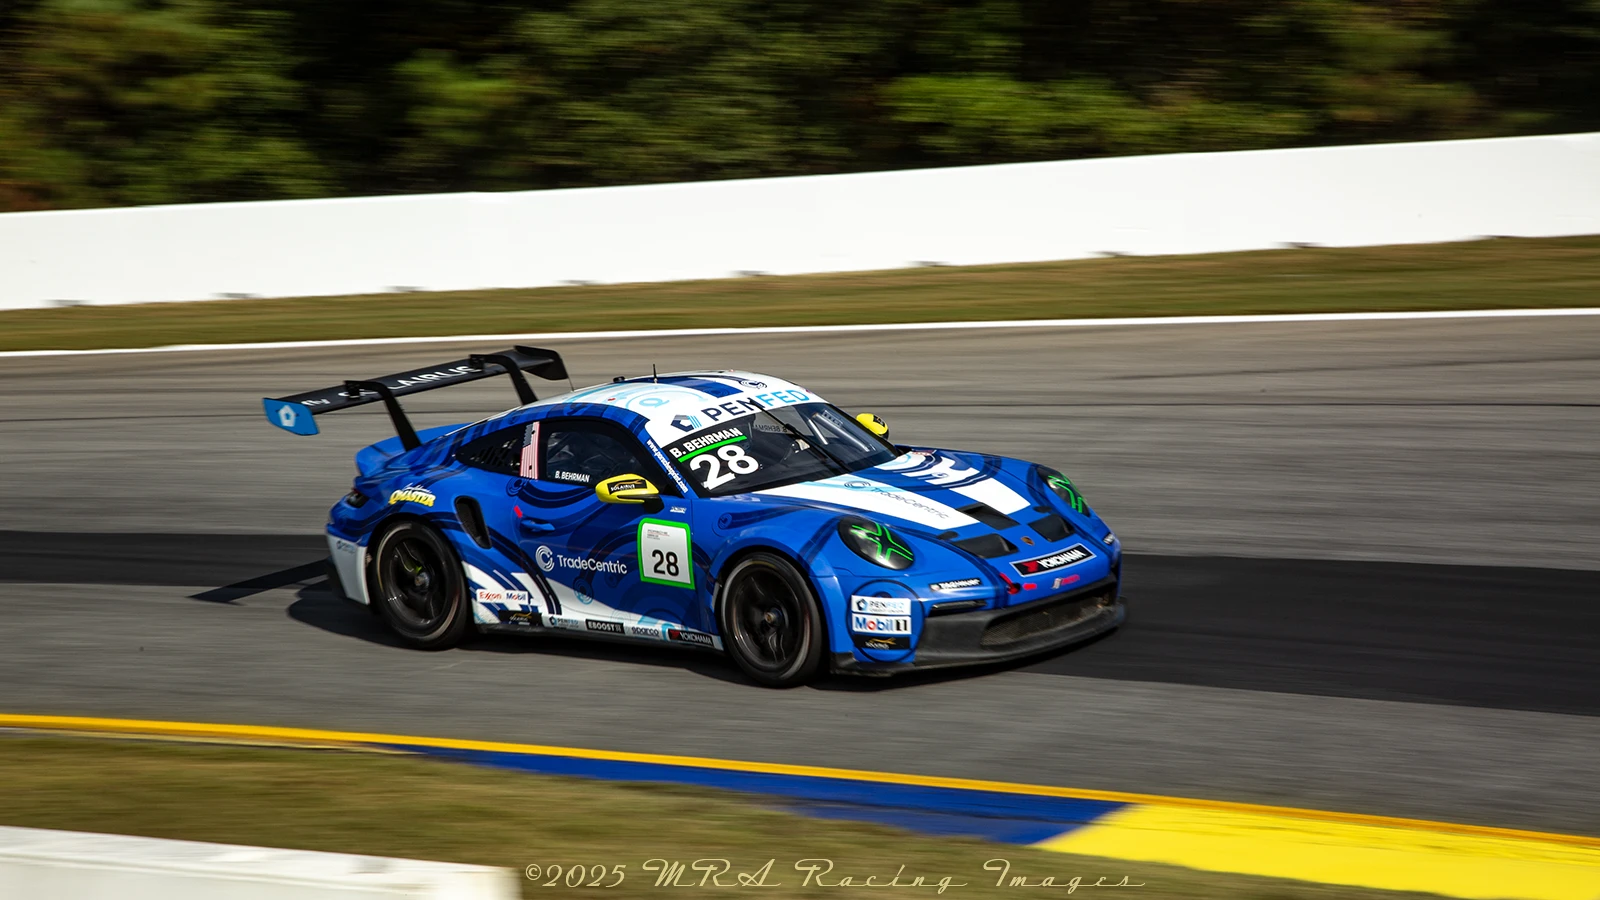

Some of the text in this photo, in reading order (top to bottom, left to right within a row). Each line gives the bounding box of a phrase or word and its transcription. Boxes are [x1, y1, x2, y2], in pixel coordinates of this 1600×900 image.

[701, 389, 810, 422] PENFED
[669, 427, 743, 459] B. BEHRMAN
[555, 470, 590, 483] B. BEHRMAN
[690, 445, 759, 490] 28
[557, 554, 628, 574] TradeCentric
[652, 549, 679, 576] 28
[1037, 549, 1087, 569] YOKOHAMA
[479, 591, 527, 601] Exxon Mobil
[855, 616, 894, 631] Mobil
[680, 632, 713, 645] YOKOHAMA
